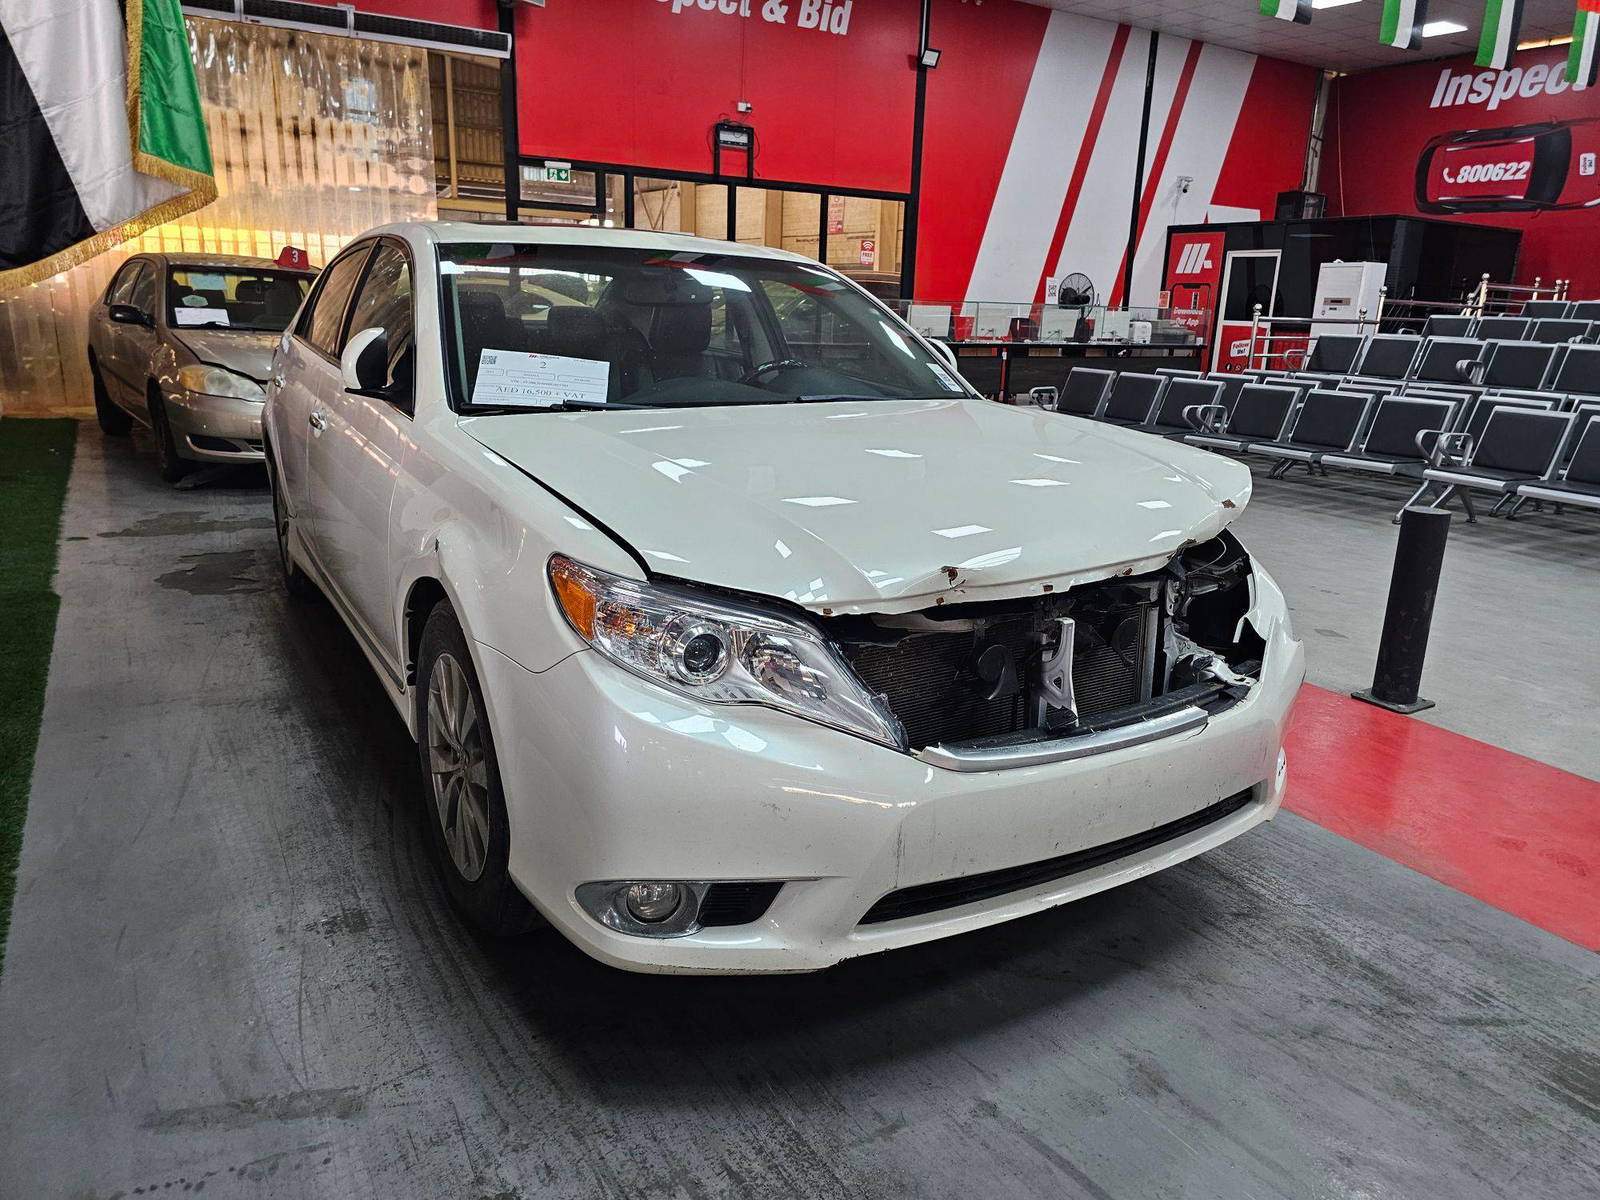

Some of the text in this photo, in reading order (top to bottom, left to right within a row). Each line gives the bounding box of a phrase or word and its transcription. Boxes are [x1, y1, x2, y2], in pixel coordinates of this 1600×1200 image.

[761, 0, 789, 24] &
[797, 0, 852, 36] Bid
[1456, 161, 1531, 184] 800622
[292, 250, 299, 263] 3
[539, 361, 547, 369] 2
